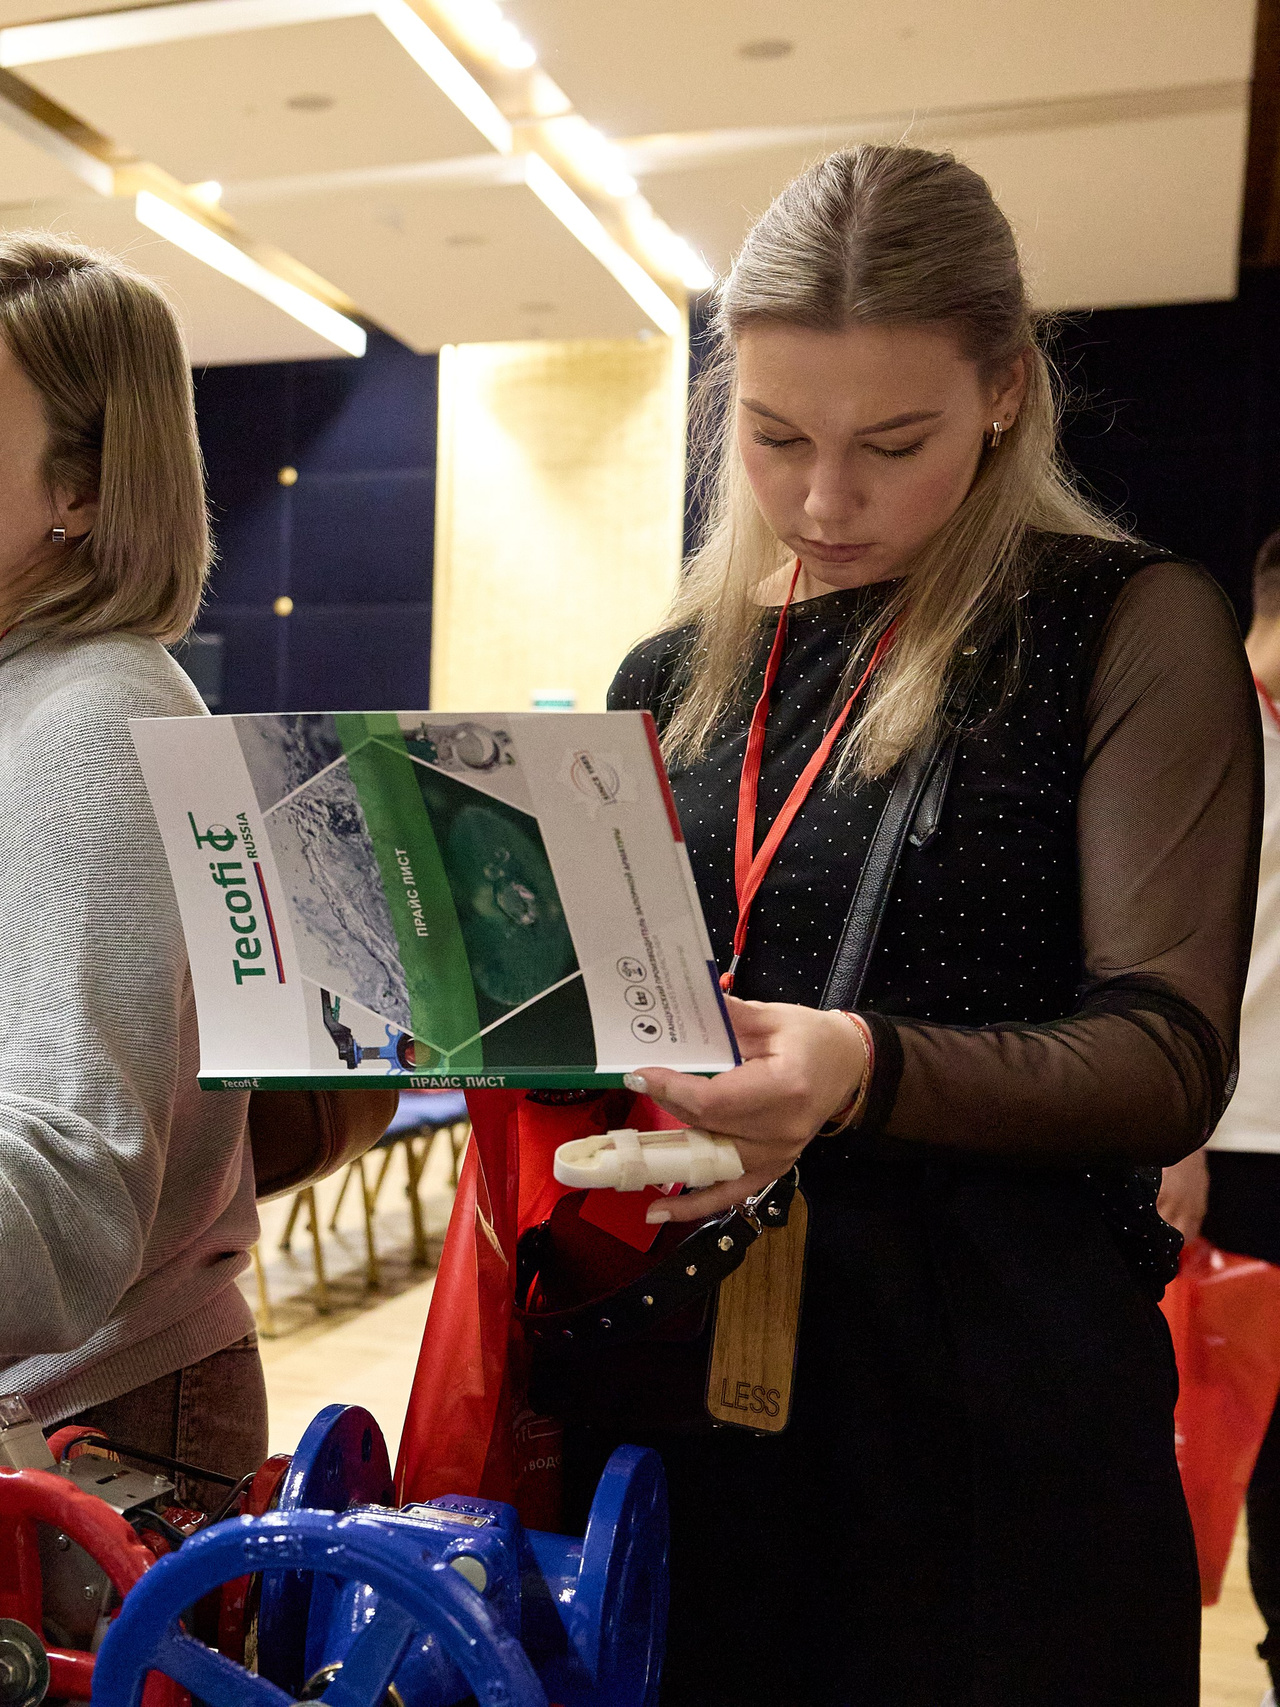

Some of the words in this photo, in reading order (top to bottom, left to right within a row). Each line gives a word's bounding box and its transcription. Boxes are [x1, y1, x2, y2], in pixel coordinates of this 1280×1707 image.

[236, 812, 258, 859] RUSSIA
[395, 848, 416, 886] ЛИСТ
[209, 862, 266, 985] Tecofi
[407, 889, 429, 937] ПРАЙС
[221, 1079, 252, 1088] Tecofi
[465, 1076, 506, 1087] ЛИСТ
[721, 1378, 781, 1418] LESS
